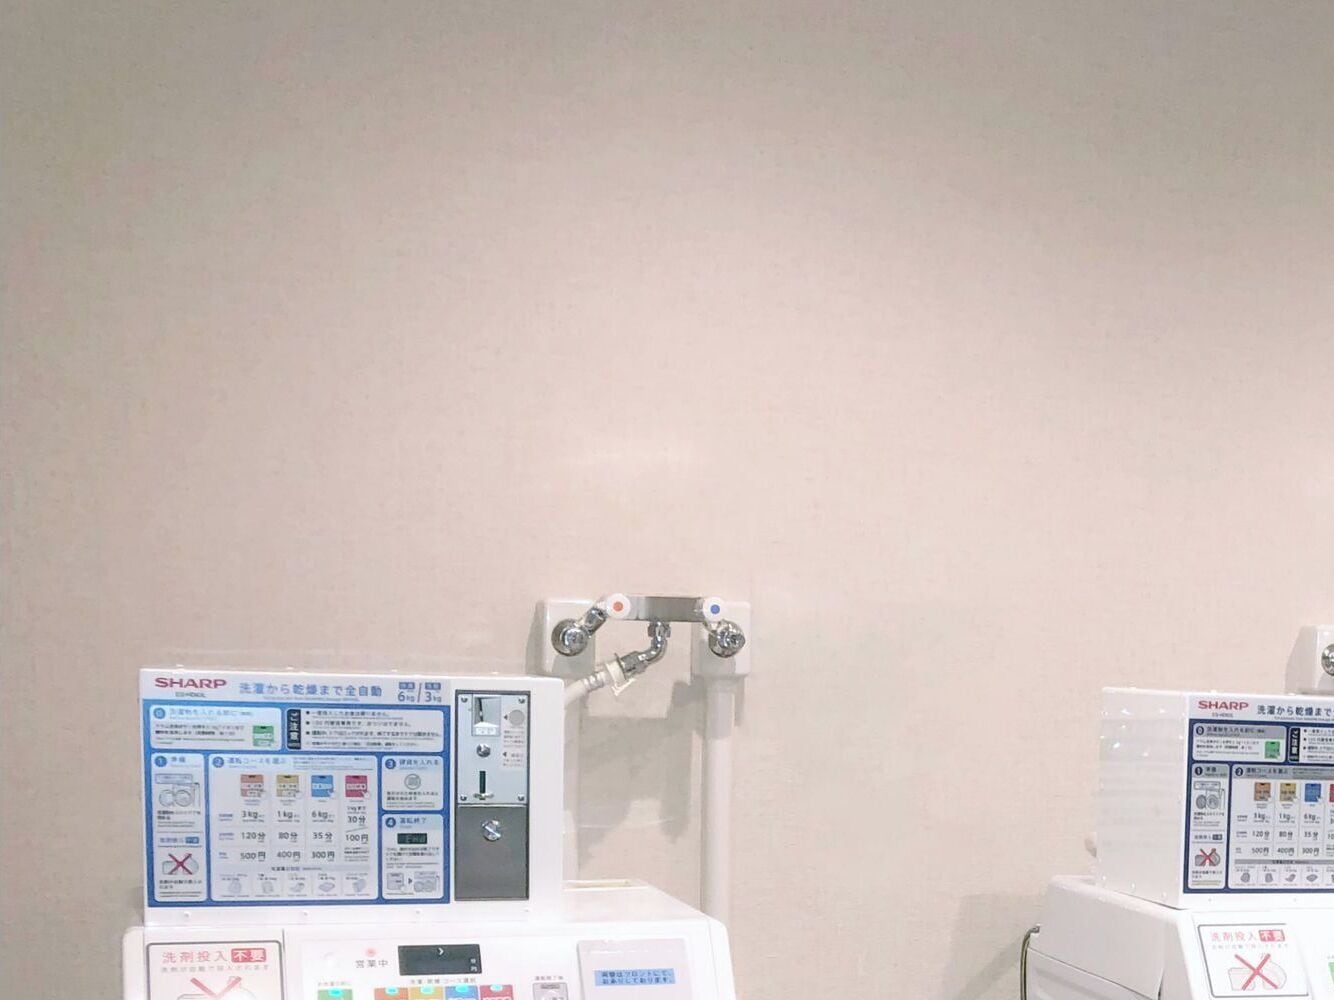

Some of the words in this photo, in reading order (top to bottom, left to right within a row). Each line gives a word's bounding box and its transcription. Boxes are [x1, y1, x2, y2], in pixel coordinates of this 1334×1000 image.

[154, 677, 227, 689] SHARP
[239, 682, 382, 698] 洗濯から乾燥まで全自動
[1198, 701, 1249, 711] SHARP
[162, 950, 228, 964] 洗剤投入
[233, 949, 266, 961] 不要
[355, 959, 389, 969] 営業中
